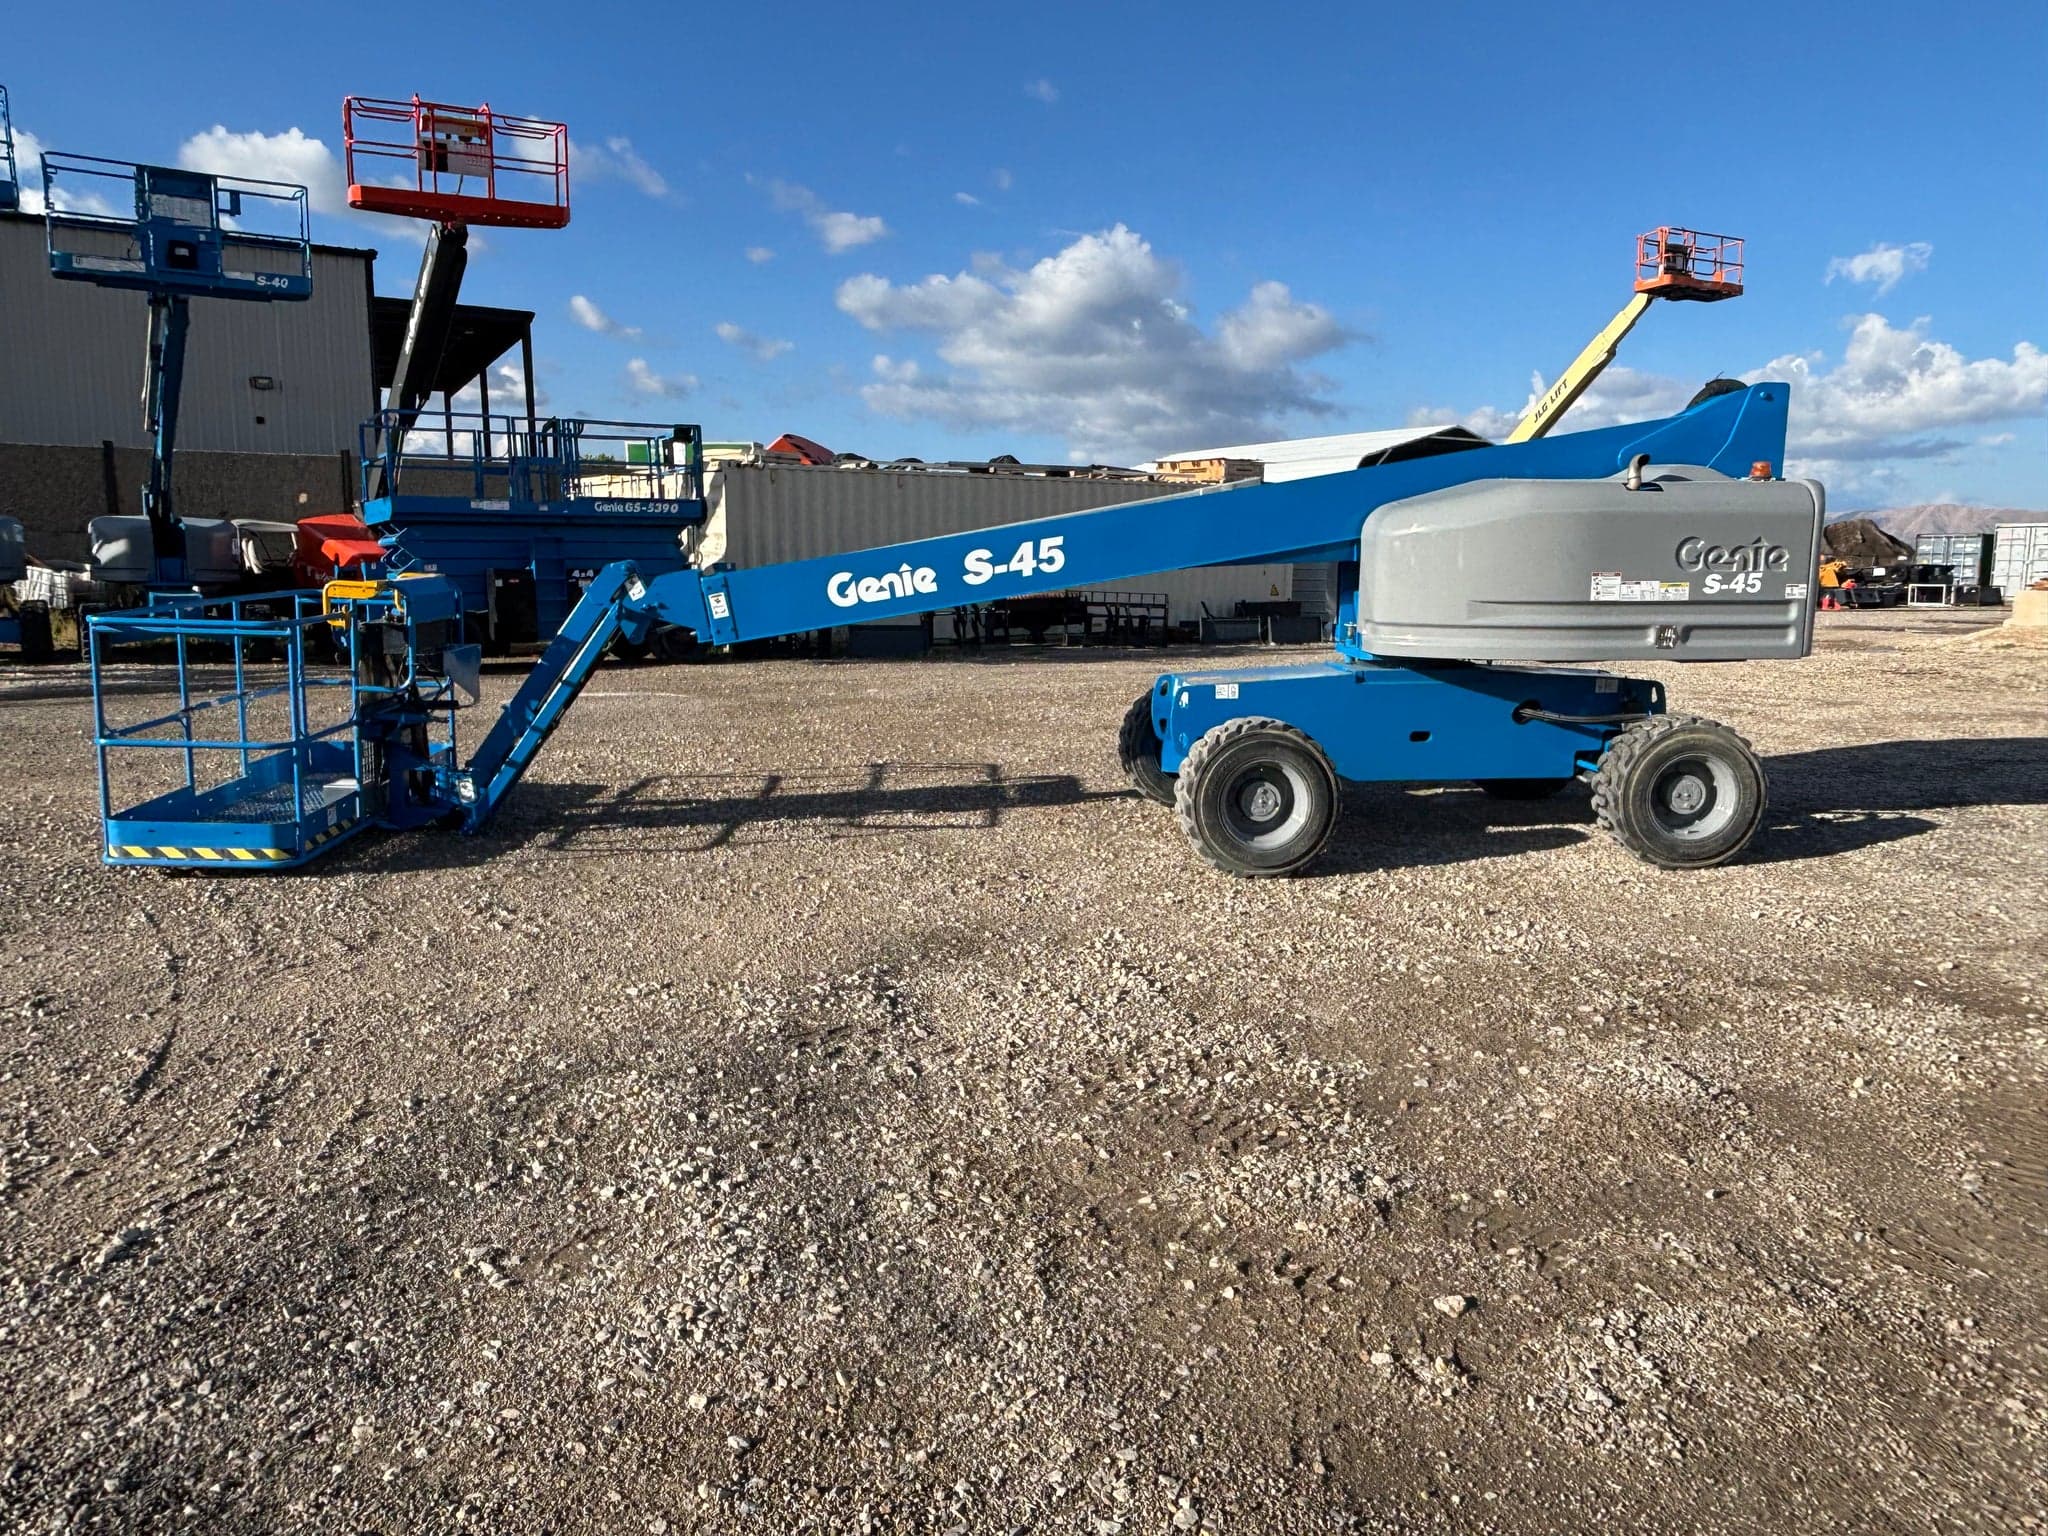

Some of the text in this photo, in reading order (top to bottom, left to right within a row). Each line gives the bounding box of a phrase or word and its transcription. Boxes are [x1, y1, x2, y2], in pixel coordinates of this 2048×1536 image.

[256, 275, 288, 289] S-40
[1534, 379, 1567, 423] JLG LIFT
[594, 502, 679, 514] Genie GS-5390
[1675, 535, 1790, 573] Genie
[827, 535, 1066, 608] Genie S-45
[1702, 572, 1763, 595] S-45
